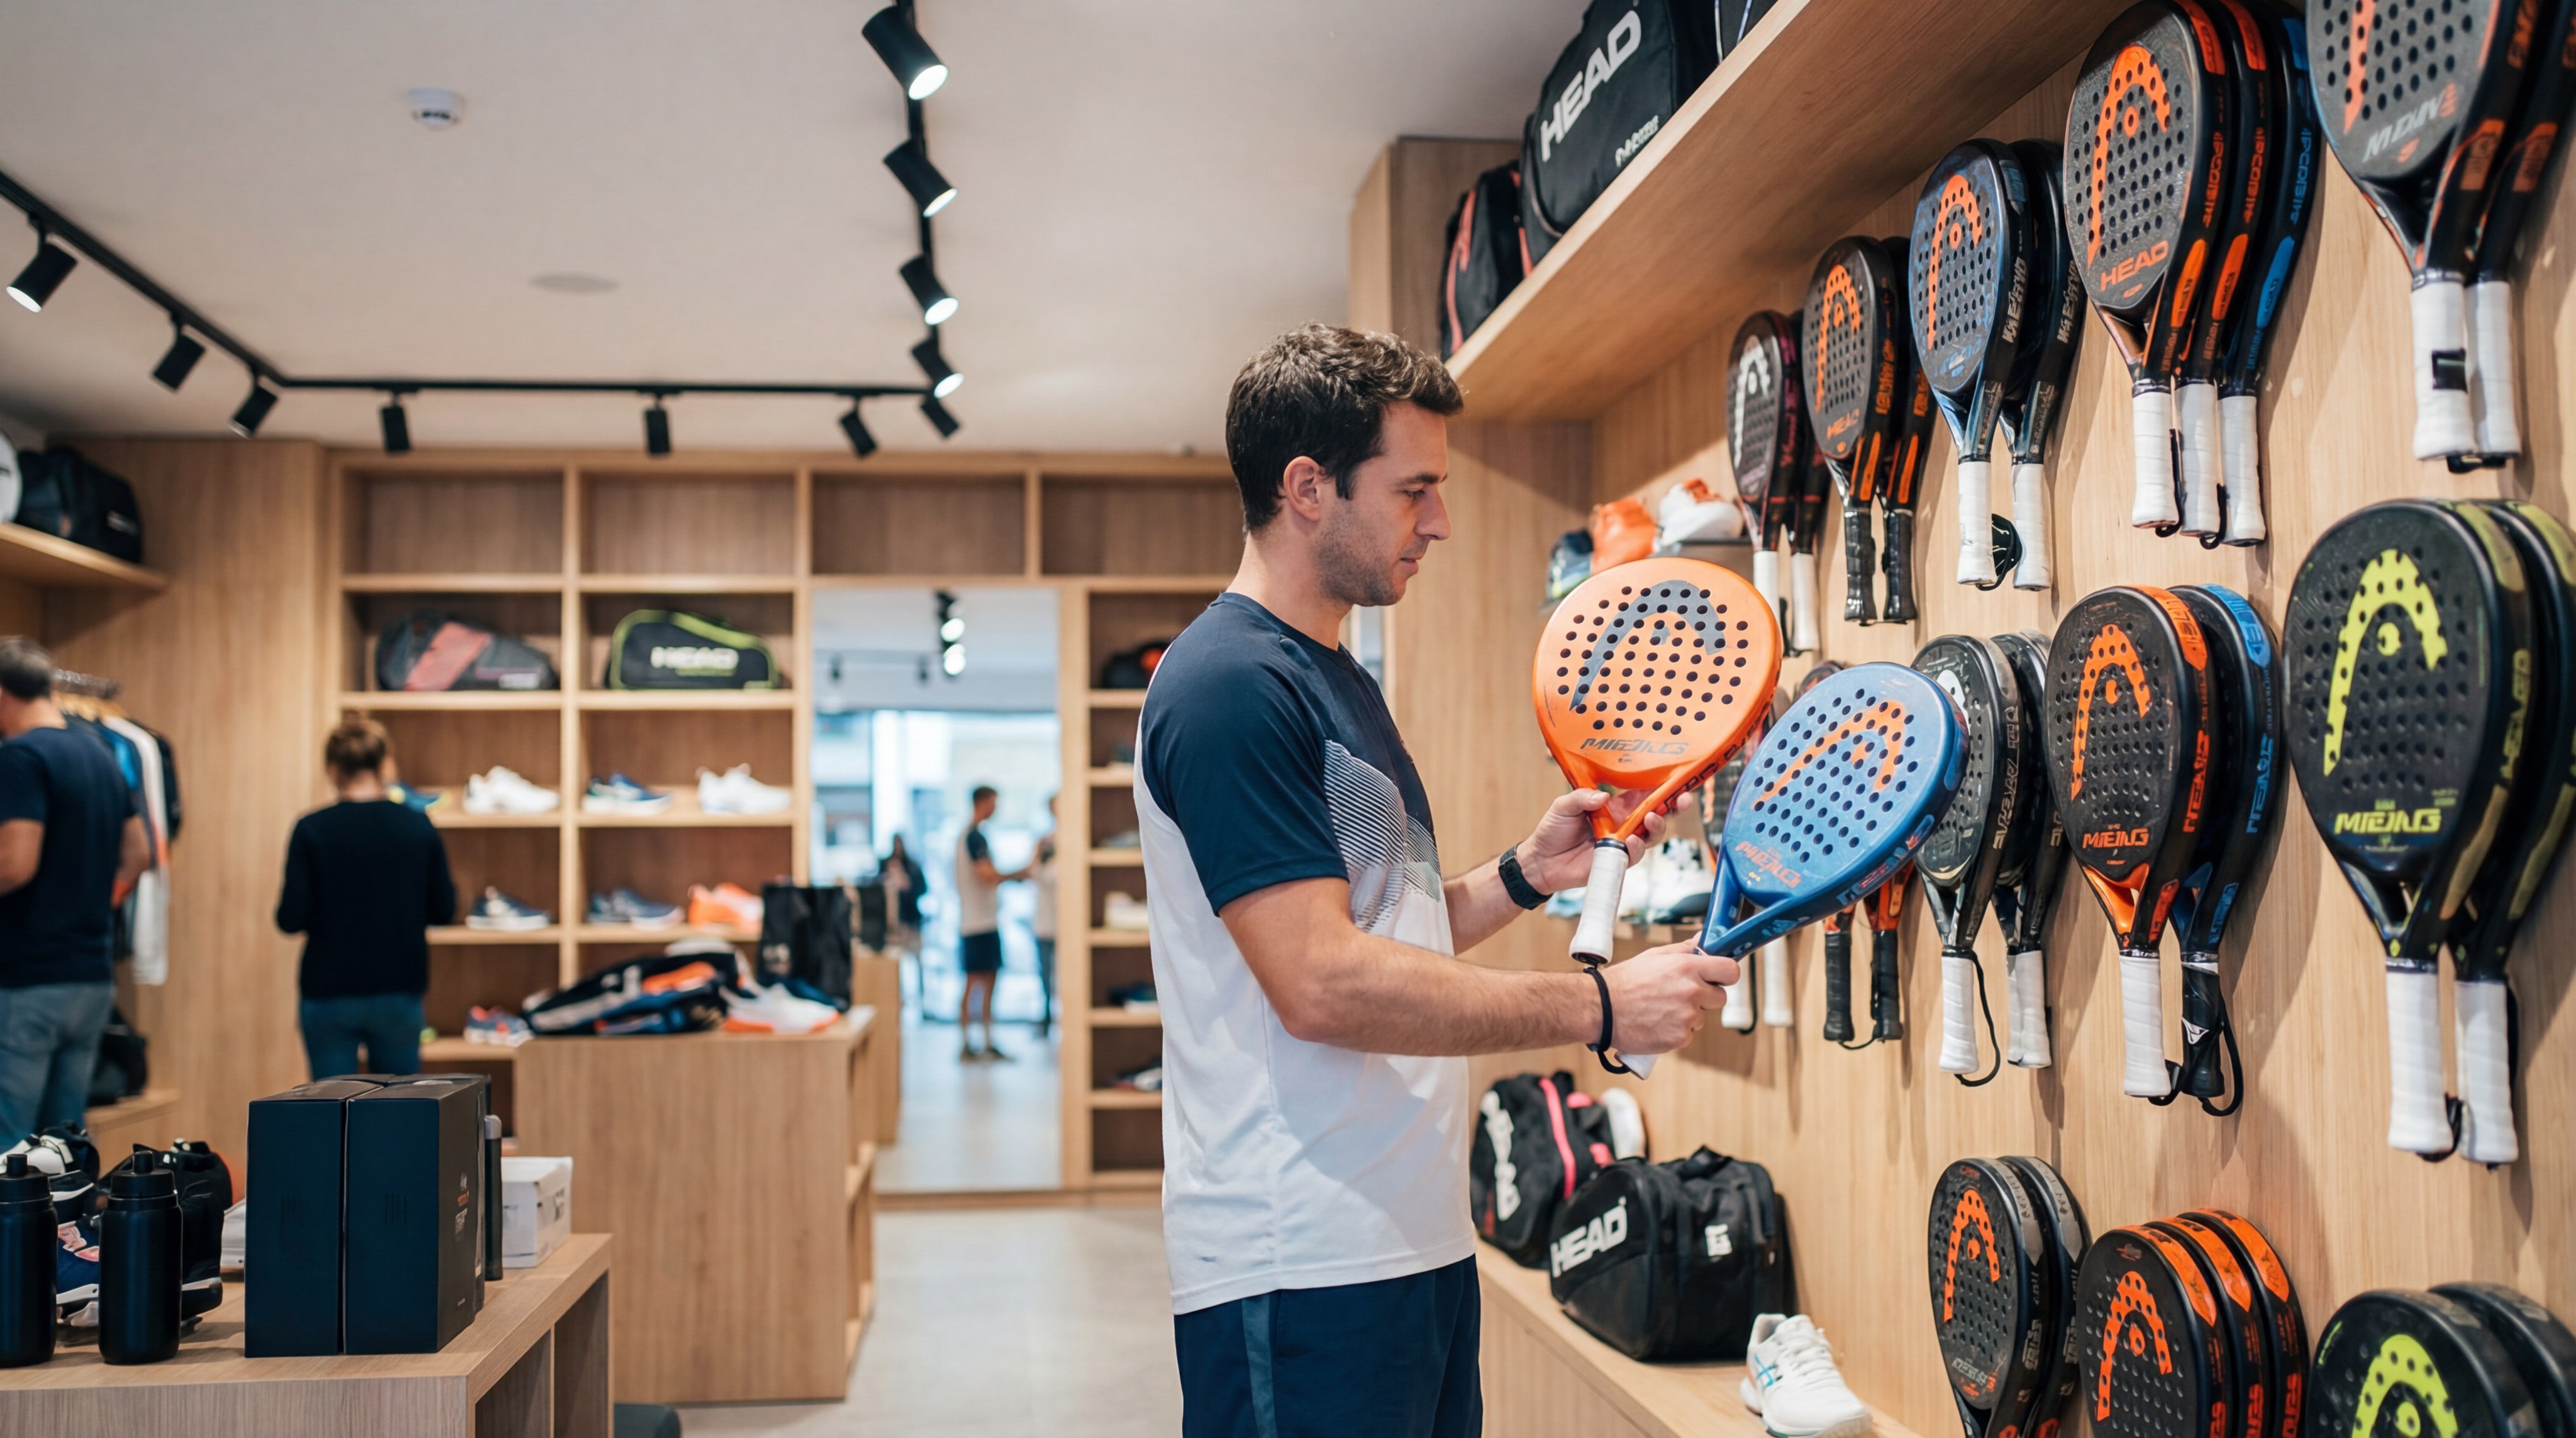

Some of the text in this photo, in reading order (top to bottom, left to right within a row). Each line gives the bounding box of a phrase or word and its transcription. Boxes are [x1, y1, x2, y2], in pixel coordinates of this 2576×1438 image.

[1541, 9, 1641, 162] HEAD
[2101, 240, 2169, 292] HEAD
[1550, 1204, 1627, 1278] HEAD
